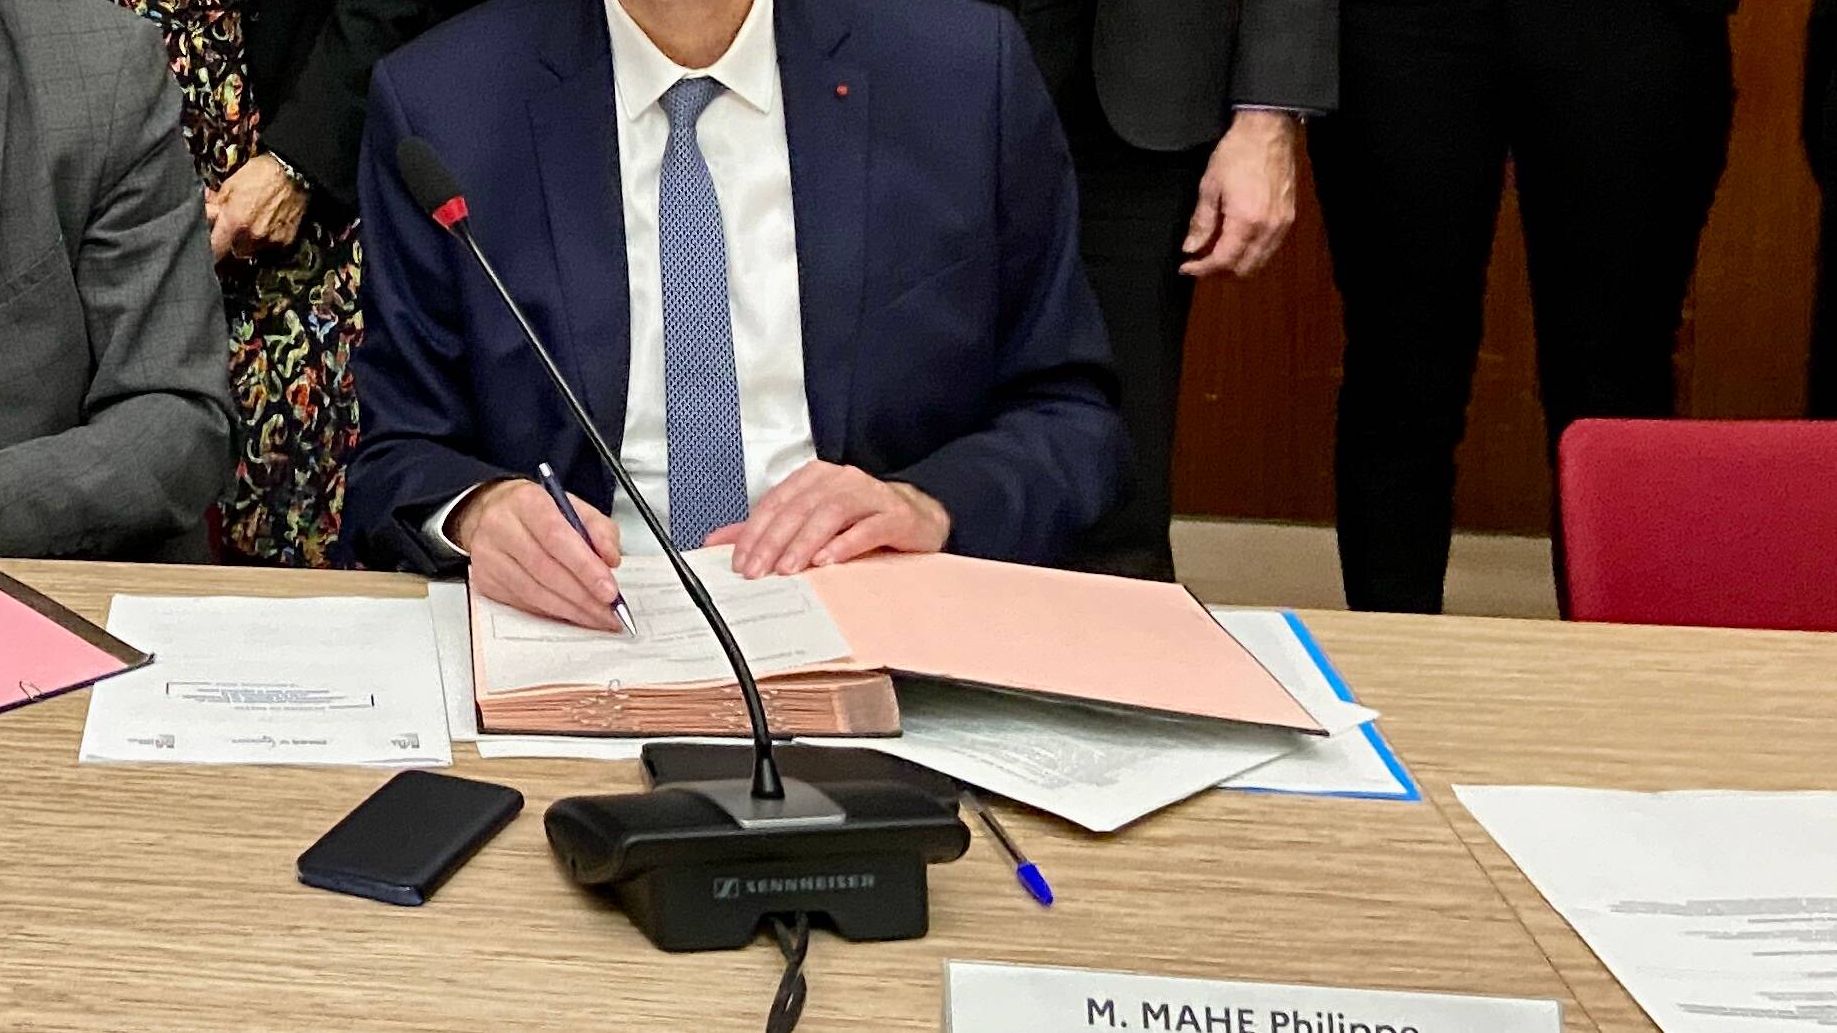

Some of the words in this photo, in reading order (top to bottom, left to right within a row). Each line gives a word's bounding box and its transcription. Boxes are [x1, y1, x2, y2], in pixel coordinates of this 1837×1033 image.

[1087, 997, 1128, 1028] M.
[1142, 1001, 1254, 1033] MAHE
[1270, 1010, 1420, 1033] Phili
